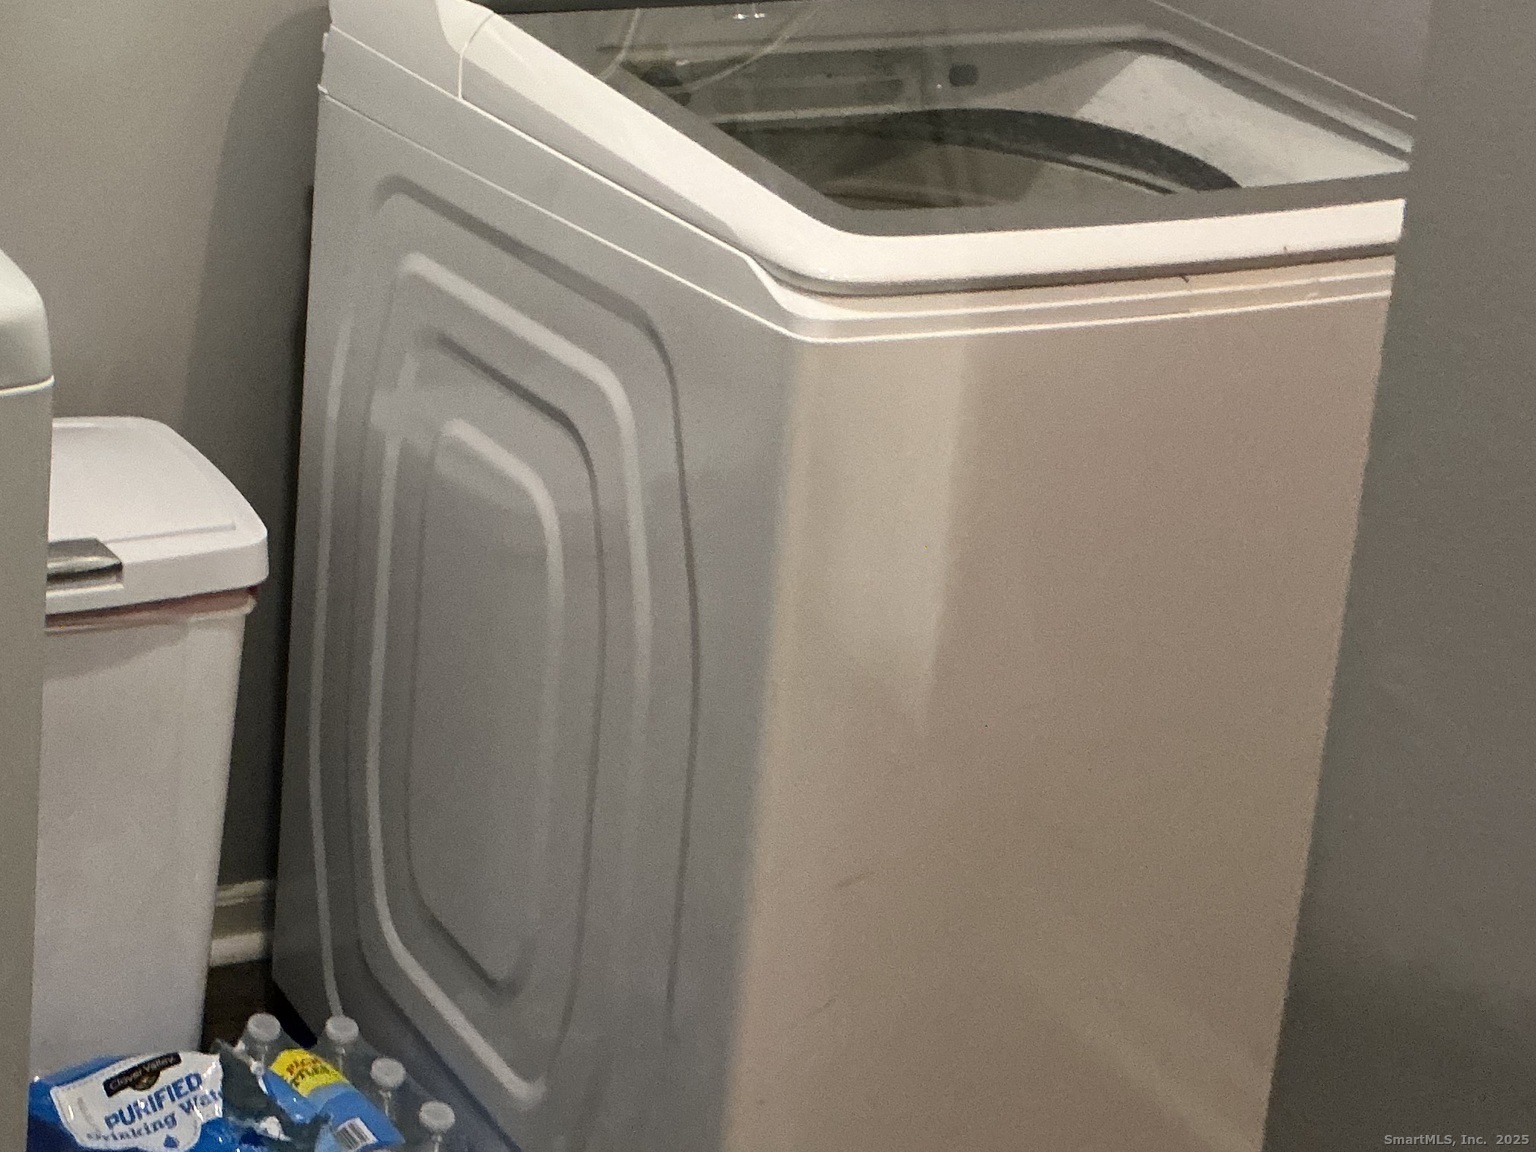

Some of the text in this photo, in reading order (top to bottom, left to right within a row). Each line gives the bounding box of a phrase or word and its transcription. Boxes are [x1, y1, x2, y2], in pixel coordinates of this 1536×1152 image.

[86, 1089, 223, 1142] Drinking Wat
[104, 1072, 203, 1131] PURIFIED
